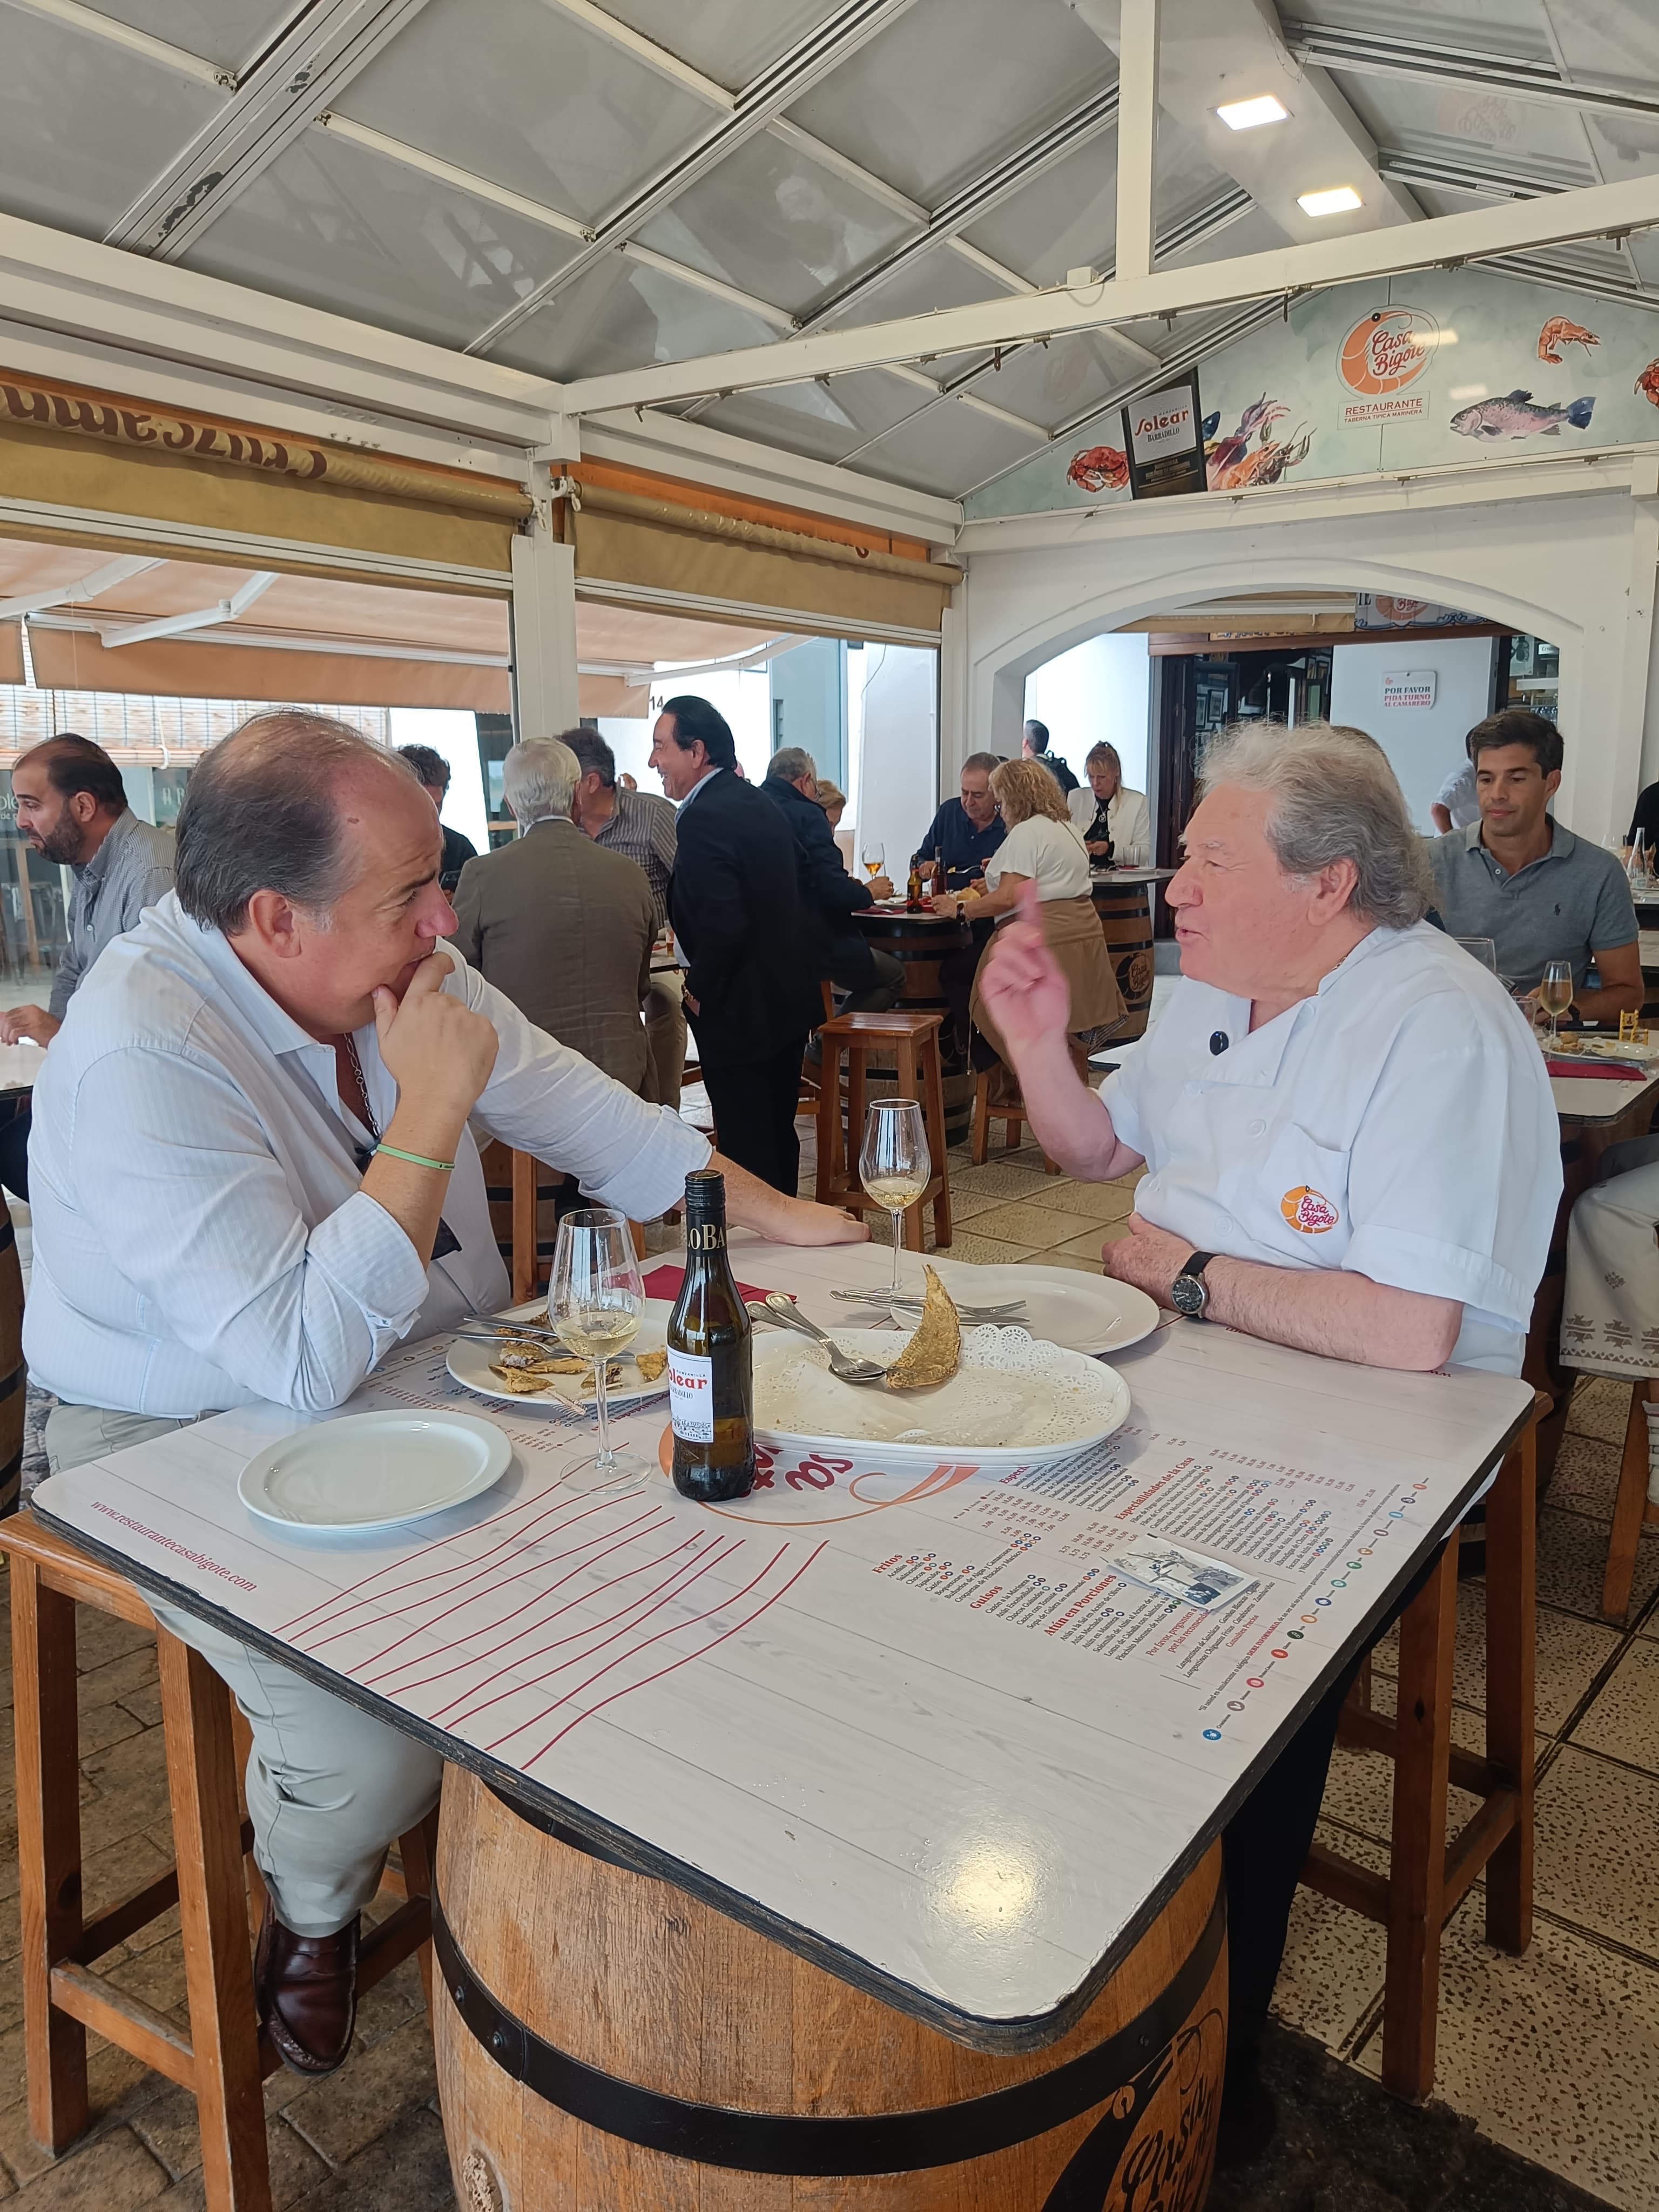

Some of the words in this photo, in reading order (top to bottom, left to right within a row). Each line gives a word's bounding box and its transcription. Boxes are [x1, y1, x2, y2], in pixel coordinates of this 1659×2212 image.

[1372, 329, 1413, 355] Casa
[1373, 343, 1425, 376] Bigote
[1344, 413, 1371, 423] TABERNA
[1392, 409, 1422, 417] MARINERA
[1345, 398, 1422, 415] RESTAURANTE
[1135, 410, 1189, 436] Solear
[1148, 427, 1179, 442] BARBADILLO
[1298, 1210, 1334, 1226] Bigote
[1301, 1196, 1328, 1213] Casa
[668, 1366, 707, 1390] olear
[1114, 1481, 1166, 1520] Especialidades
[1175, 1457, 1195, 1469] Casa
[91, 1501, 257, 1591] www.restaurantecasabigote.com
[871, 1554, 902, 1573] Fritos
[887, 1564, 907, 1578] Acedías
[895, 1561, 925, 1581] Salmonetes
[954, 1584, 980, 1602] Croquetas
[982, 1566, 1003, 1580] Pescado
[1002, 1550, 1022, 1564] Marisco
[972, 1568, 986, 1578] Algas
[986, 1548, 1013, 1566] Camarones
[906, 1572, 926, 1584] Chocos
[914, 1570, 941, 1588] Tapaculos
[925, 1580, 942, 1591] Cazón
[934, 1574, 964, 1595] Boquerones
[969, 1586, 1002, 1608] Guisos
[985, 1601, 1003, 1613] Cazón
[1006, 1579, 1030, 1596] Marinera
[995, 1608, 1010, 1618] Atún
[1006, 1586, 1036, 1608] Encebollado
[1006, 1607, 1026, 1621] Chocos
[1022, 1590, 1044, 1607] Guisados
[1016, 1613, 1034, 1624] Cazón
[1031, 1605, 1042, 1613] con
[1037, 1592, 1057, 1606] Tomate
[1043, 1617, 1069, 1636] Atún
[1064, 1608, 1080, 1617] en
[1073, 1574, 1116, 1608] Porciones
[1026, 1618, 1042, 1629] Sopa
[1043, 1602, 1061, 1614] Galera
[1060, 1630, 1074, 1641] Atún
[1090, 1601, 1106, 1613] Aceite
[1107, 1587, 1122, 1596] Oliva
[1092, 1633, 1116, 1653] Solomillo
[1117, 1618, 1132, 1629] Atún
[1131, 1603, 1148, 1616] Aceite
[1149, 1590, 1163, 1600] Ajos
[1182, 1608, 1214, 1636] recomendac
[1071, 1634, 1085, 1645] Atún
[1080, 1616, 1103, 1635] Mechado
[1082, 1638, 1096, 1649] Atún
[1097, 1616, 1120, 1633] Manteca
[1103, 1644, 1120, 1656] Lomo
[1122, 1624, 1141, 1639] Caballa
[1144, 1603, 1163, 1618] Salmón
[1115, 1643, 1137, 1661] Pinchito
[1131, 1628, 1152, 1644] Moruno
[1154, 1613, 1168, 1623] Atún
[1145, 1646, 1159, 1656] Por
[1154, 1634, 1174, 1647] favor,
[1168, 1611, 1195, 1635] pregunten
[1172, 1636, 1186, 1644] las
[1176, 1645, 1202, 1669] Langostinos
[1201, 1624, 1220, 1642] Sanlúcar
[1218, 1609, 1236, 1623] Gambas
[1231, 1595, 1249, 1610] Blancas
[1225, 1628, 1247, 1647] Consulten
[1242, 1615, 1259, 1628] Precios
[1167, 1642, 1179, 1653] por
[1182, 1654, 1209, 1678] Langostinos
[1204, 1635, 1225, 1654] Chiguatos
[1220, 1625, 1235, 1636] Fritos
[1204, 1694, 1216, 1706] usted
[1215, 1671, 1237, 1691] intolerante
[1246, 1644, 1259, 1656] DEBE
[1255, 1621, 1282, 1645] INFORMARLO,
